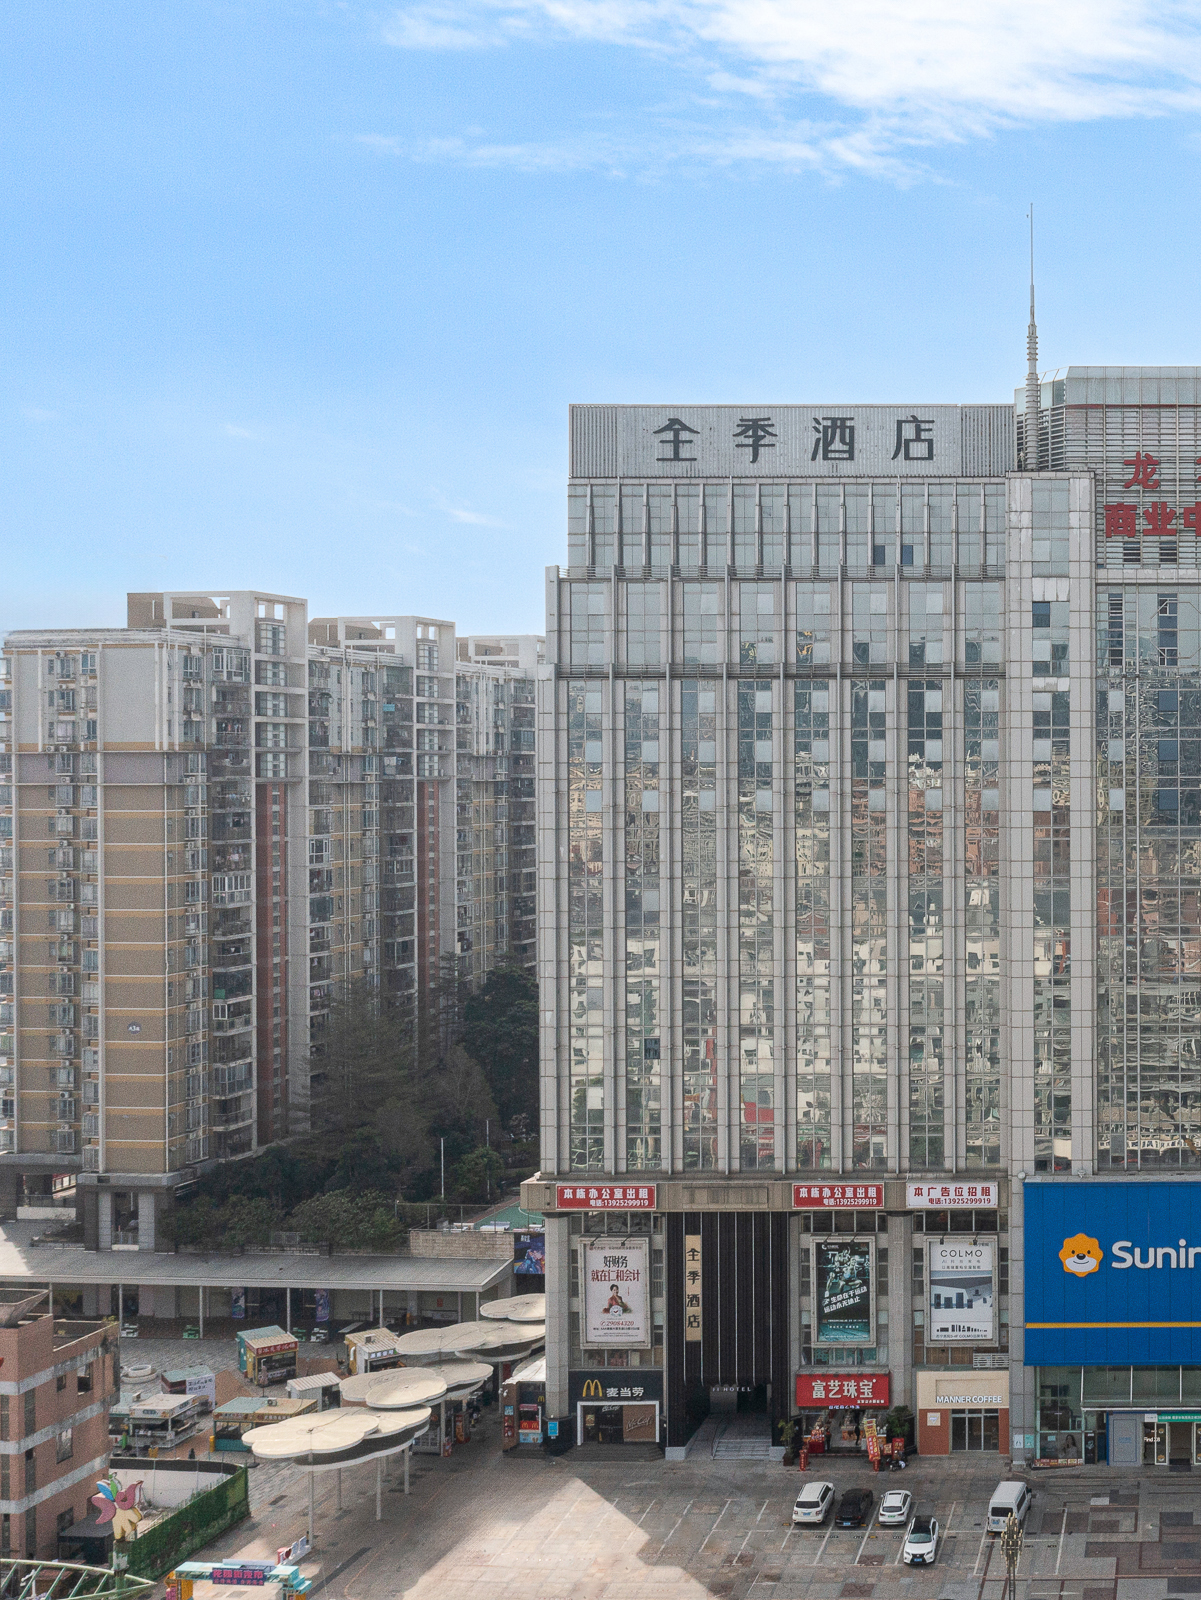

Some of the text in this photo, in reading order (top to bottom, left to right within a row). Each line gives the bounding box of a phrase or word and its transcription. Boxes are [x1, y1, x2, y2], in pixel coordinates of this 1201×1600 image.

[652, 414, 936, 463] 全季酒店
[564, 1188, 649, 1199] 本栋办公室出租
[799, 1187, 877, 1198] 本栋办公室出租
[913, 1186, 991, 1197] 本广告位招租
[589, 1199, 649, 1207] 电话:13925299919
[823, 1198, 877, 1206] 电话:13925299919
[940, 1249, 983, 1258] COLMO
[603, 1255, 628, 1268] 好财务
[591, 1269, 641, 1282] 就在仁和会计
[686, 1247, 702, 1329] 全季酒店
[606, 1386, 645, 1398] 麦当劳
[811, 1379, 874, 1399] 富艺珠宝
[936, 1395, 1003, 1404] MANNER COFFEE
